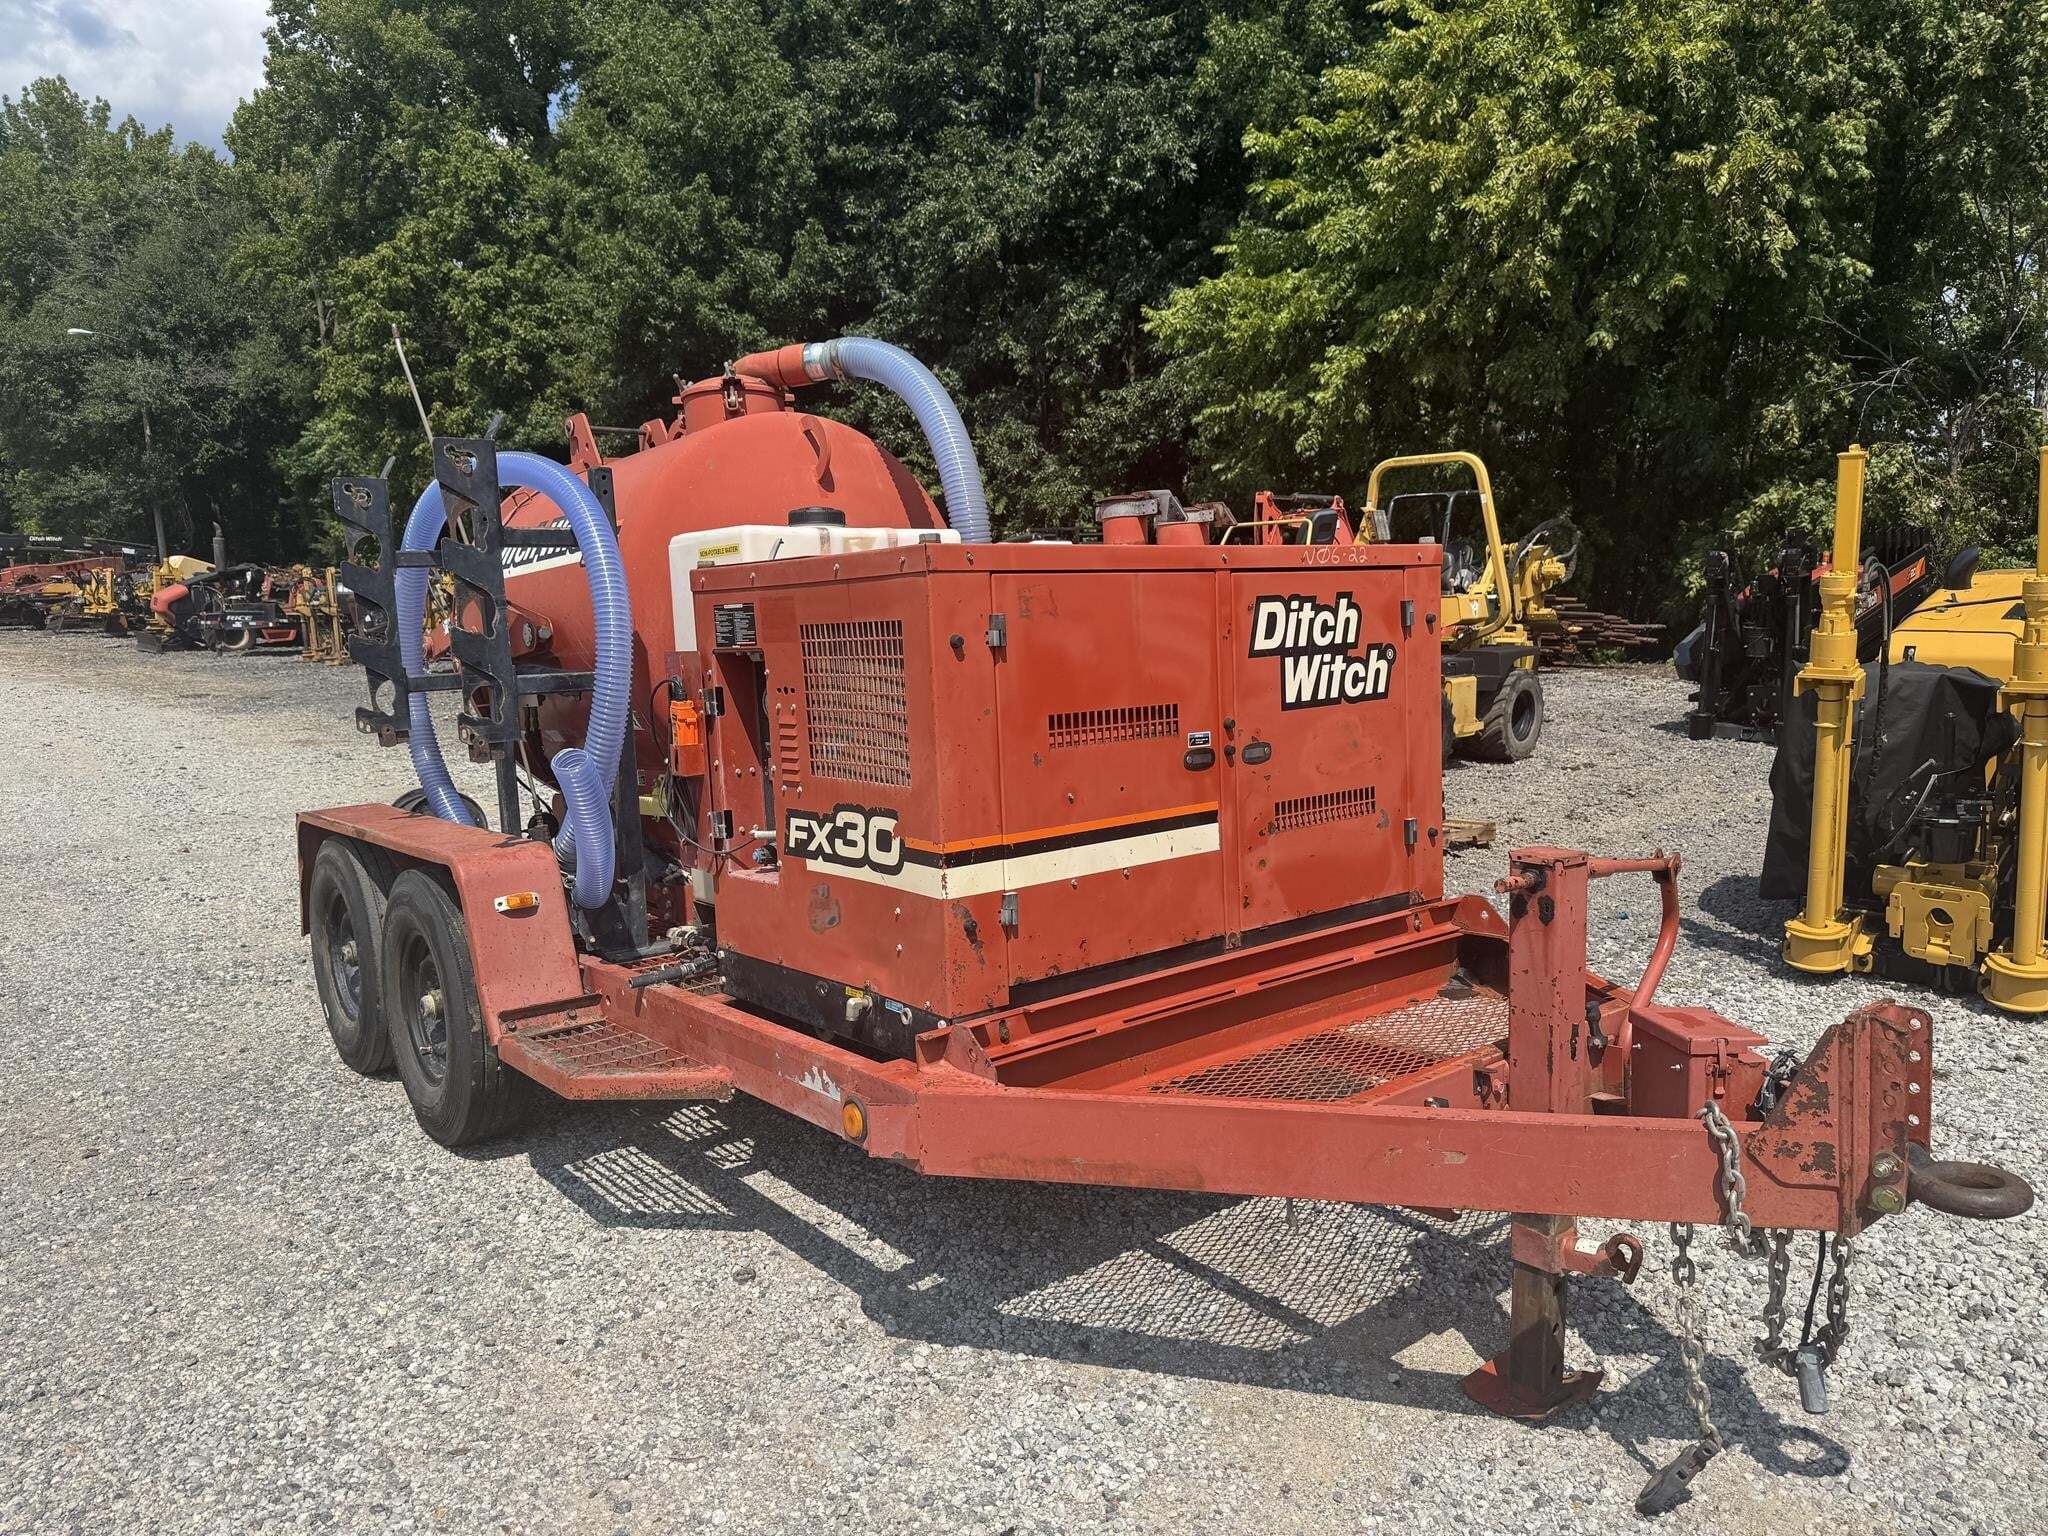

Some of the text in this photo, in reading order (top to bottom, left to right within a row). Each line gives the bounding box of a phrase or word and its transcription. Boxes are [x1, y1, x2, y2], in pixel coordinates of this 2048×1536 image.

[1254, 598, 1359, 651] Ditch
[1284, 649, 1390, 704] Witch
[788, 811, 901, 866] FX30
